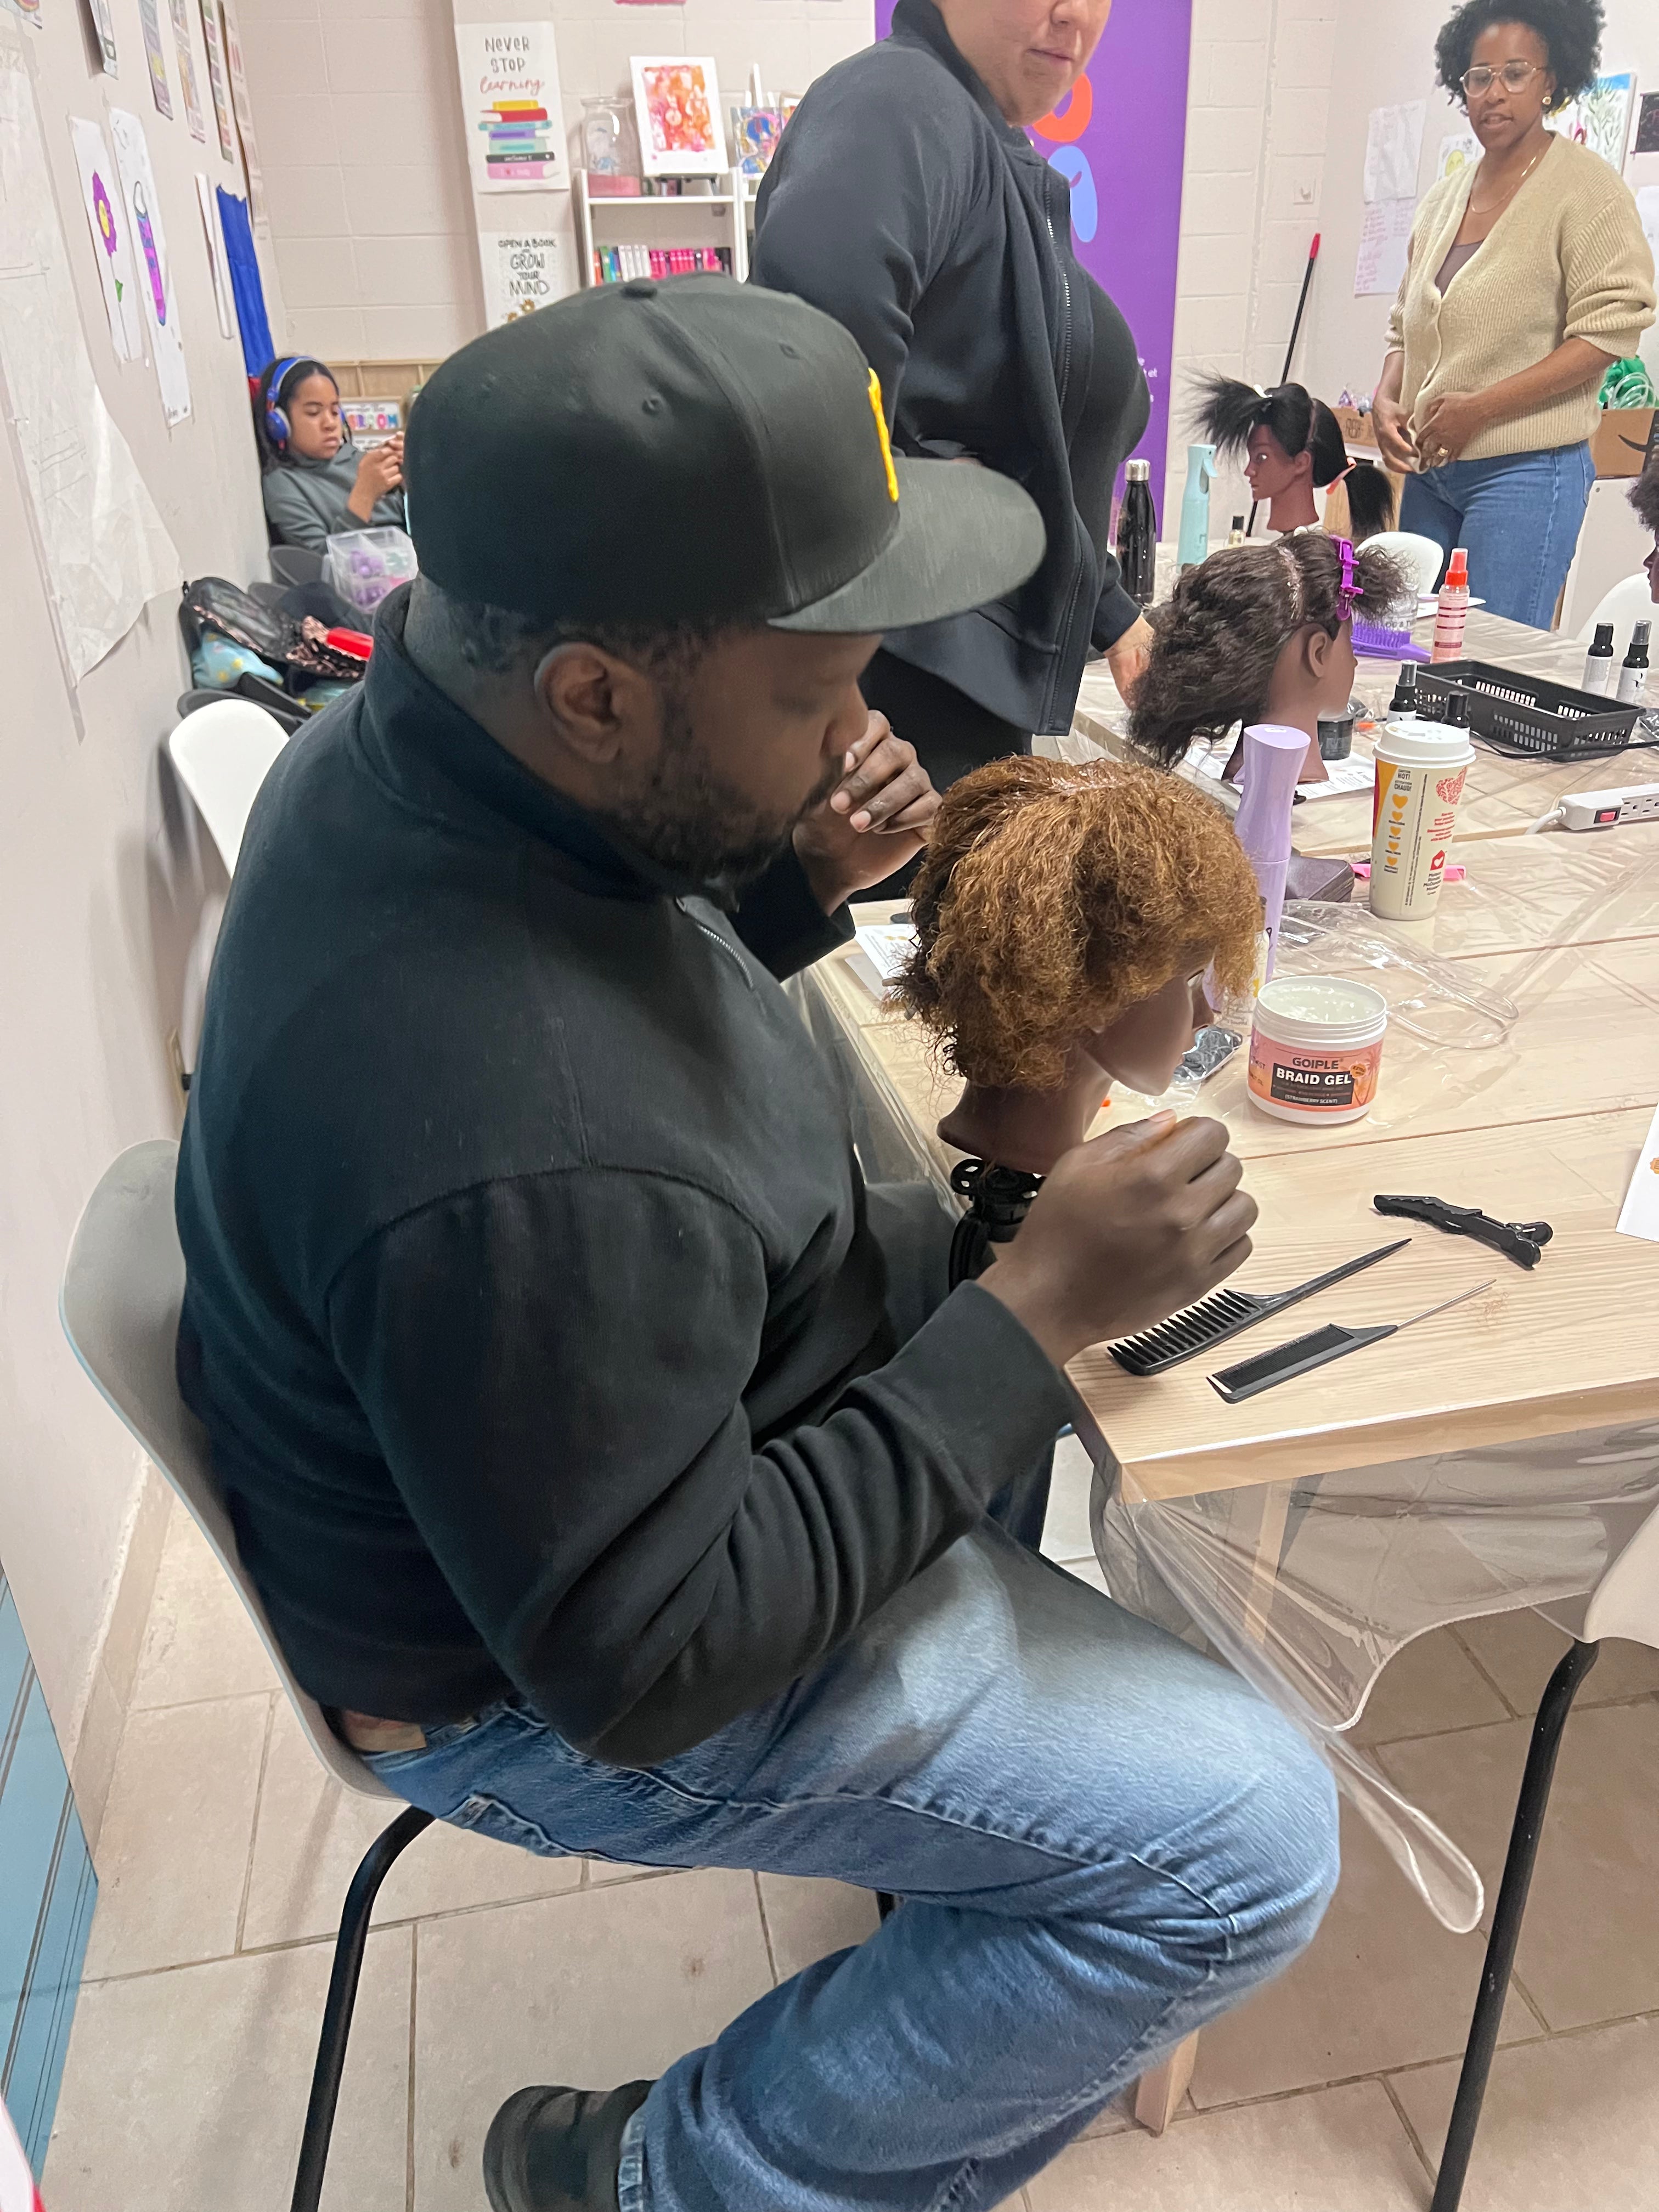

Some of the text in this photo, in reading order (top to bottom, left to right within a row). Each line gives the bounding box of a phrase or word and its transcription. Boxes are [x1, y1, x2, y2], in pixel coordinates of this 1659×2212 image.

[531, 238, 557, 248] BOOK
[510, 252, 545, 270] GROW
[510, 280, 550, 297] MIND
[1293, 1057, 1339, 1070] GOIPLE
[1276, 1067, 1321, 1085] BRAID
[1324, 1074, 1352, 1086] GEL
